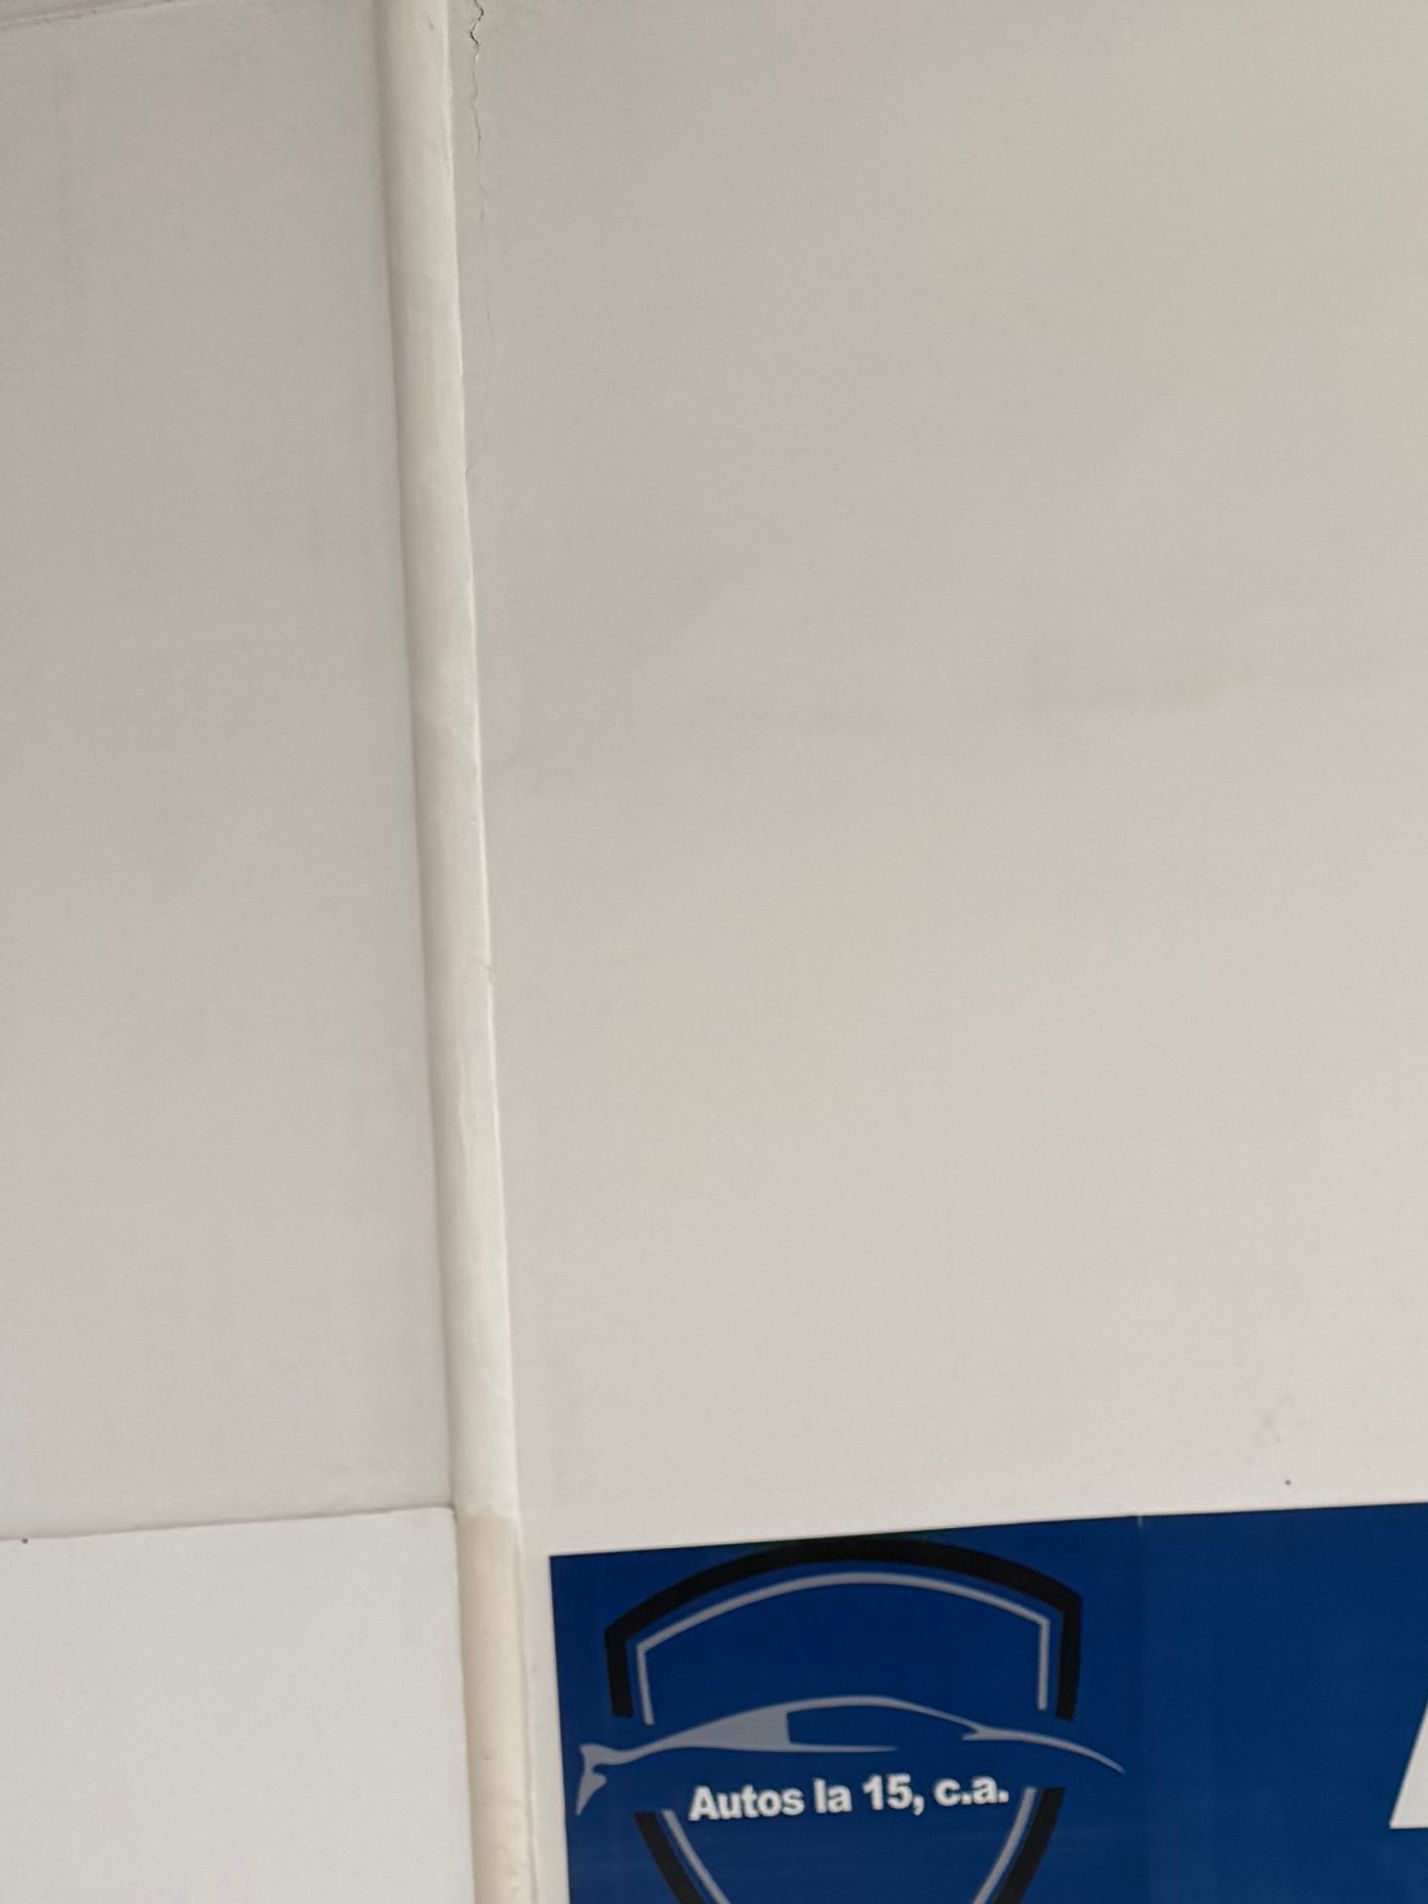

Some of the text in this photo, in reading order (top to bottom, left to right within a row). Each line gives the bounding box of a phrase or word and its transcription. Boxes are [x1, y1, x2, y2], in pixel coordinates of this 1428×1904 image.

[688, 1774, 1010, 1821] Autos la 15, c.a.
